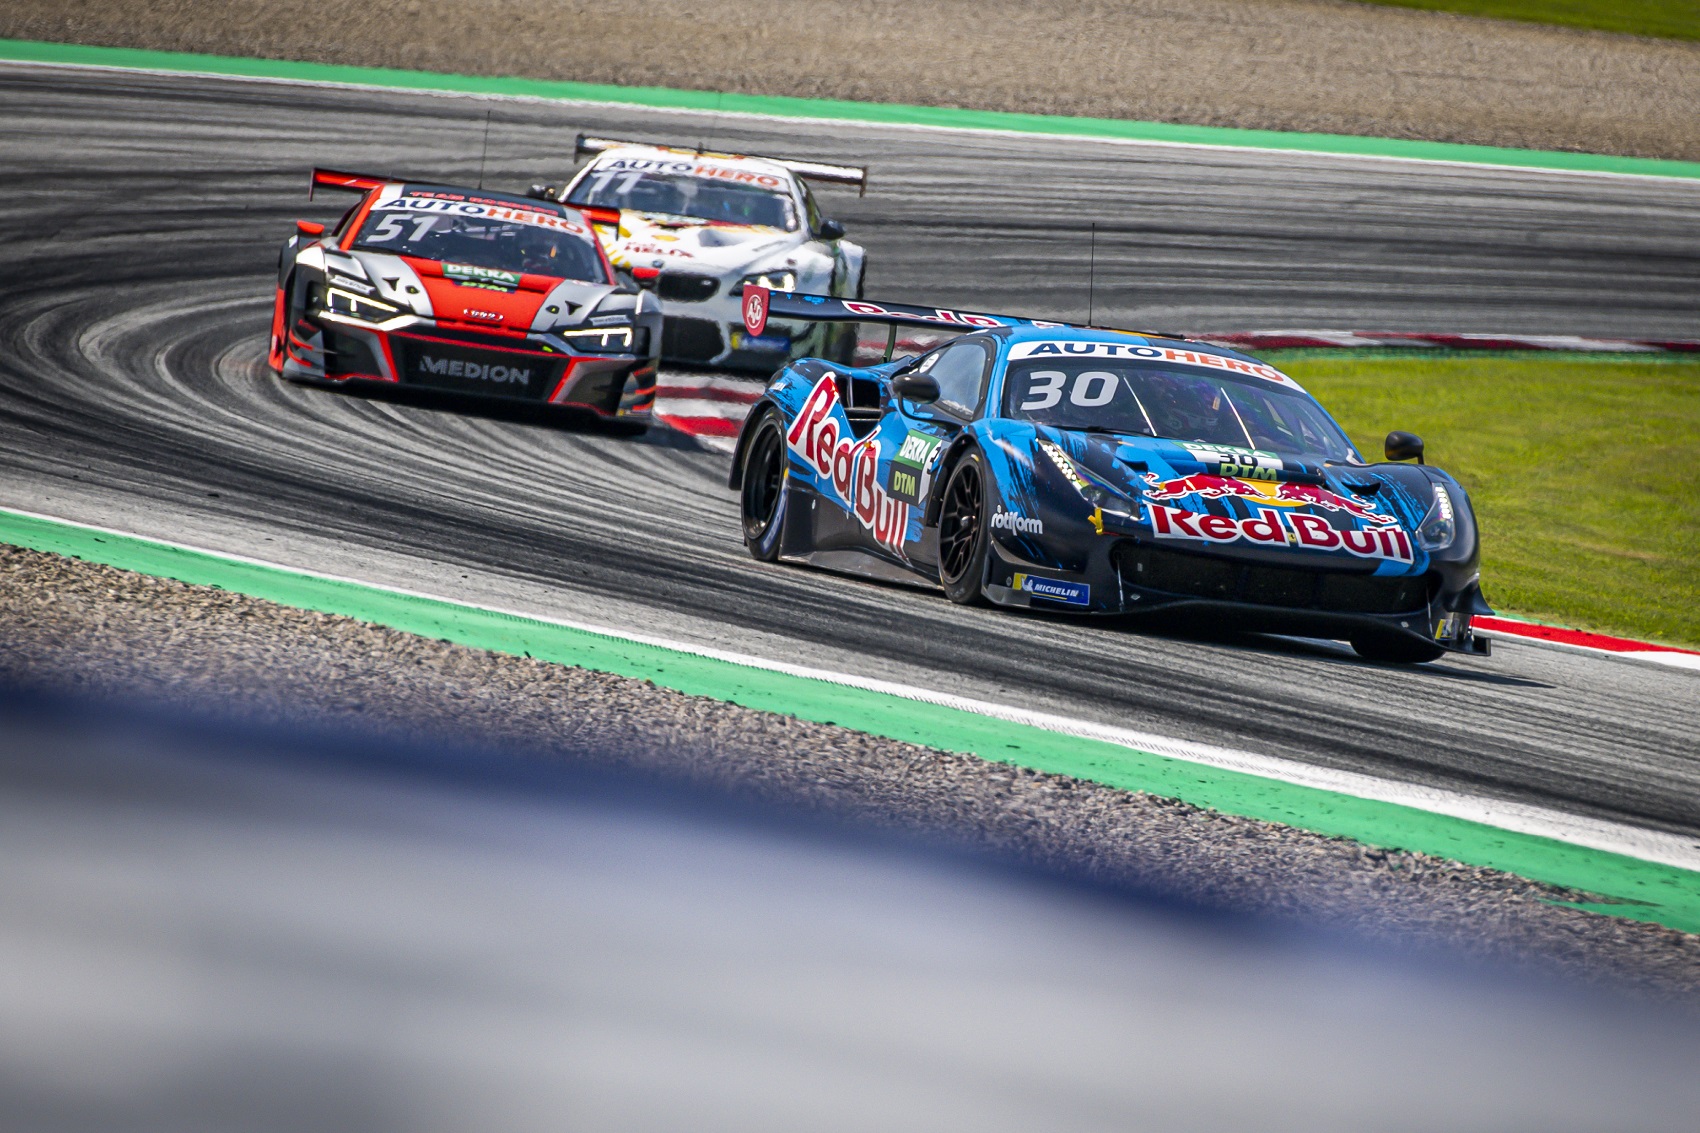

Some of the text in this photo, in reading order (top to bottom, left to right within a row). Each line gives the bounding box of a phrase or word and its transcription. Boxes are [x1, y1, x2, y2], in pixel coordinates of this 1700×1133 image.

[609, 160, 779, 187] AUTOHERO
[366, 214, 440, 242] 51
[381, 198, 584, 234] AUTOHERO
[447, 264, 515, 282] DEKRA
[420, 355, 530, 385] MEDION
[1027, 342, 1285, 382] AUTOHERO
[1019, 370, 1120, 411] 30
[899, 435, 931, 464] DEKRA
[1182, 443, 1272, 458] DEKRA
[1219, 454, 1259, 466] 30
[787, 371, 912, 566] Red Bull
[1220, 463, 1278, 481] DTM
[893, 471, 916, 497] DTM
[991, 505, 1043, 536] rotiform
[1149, 503, 1413, 562] Red Bull
[1034, 583, 1079, 597] MICHELIN
